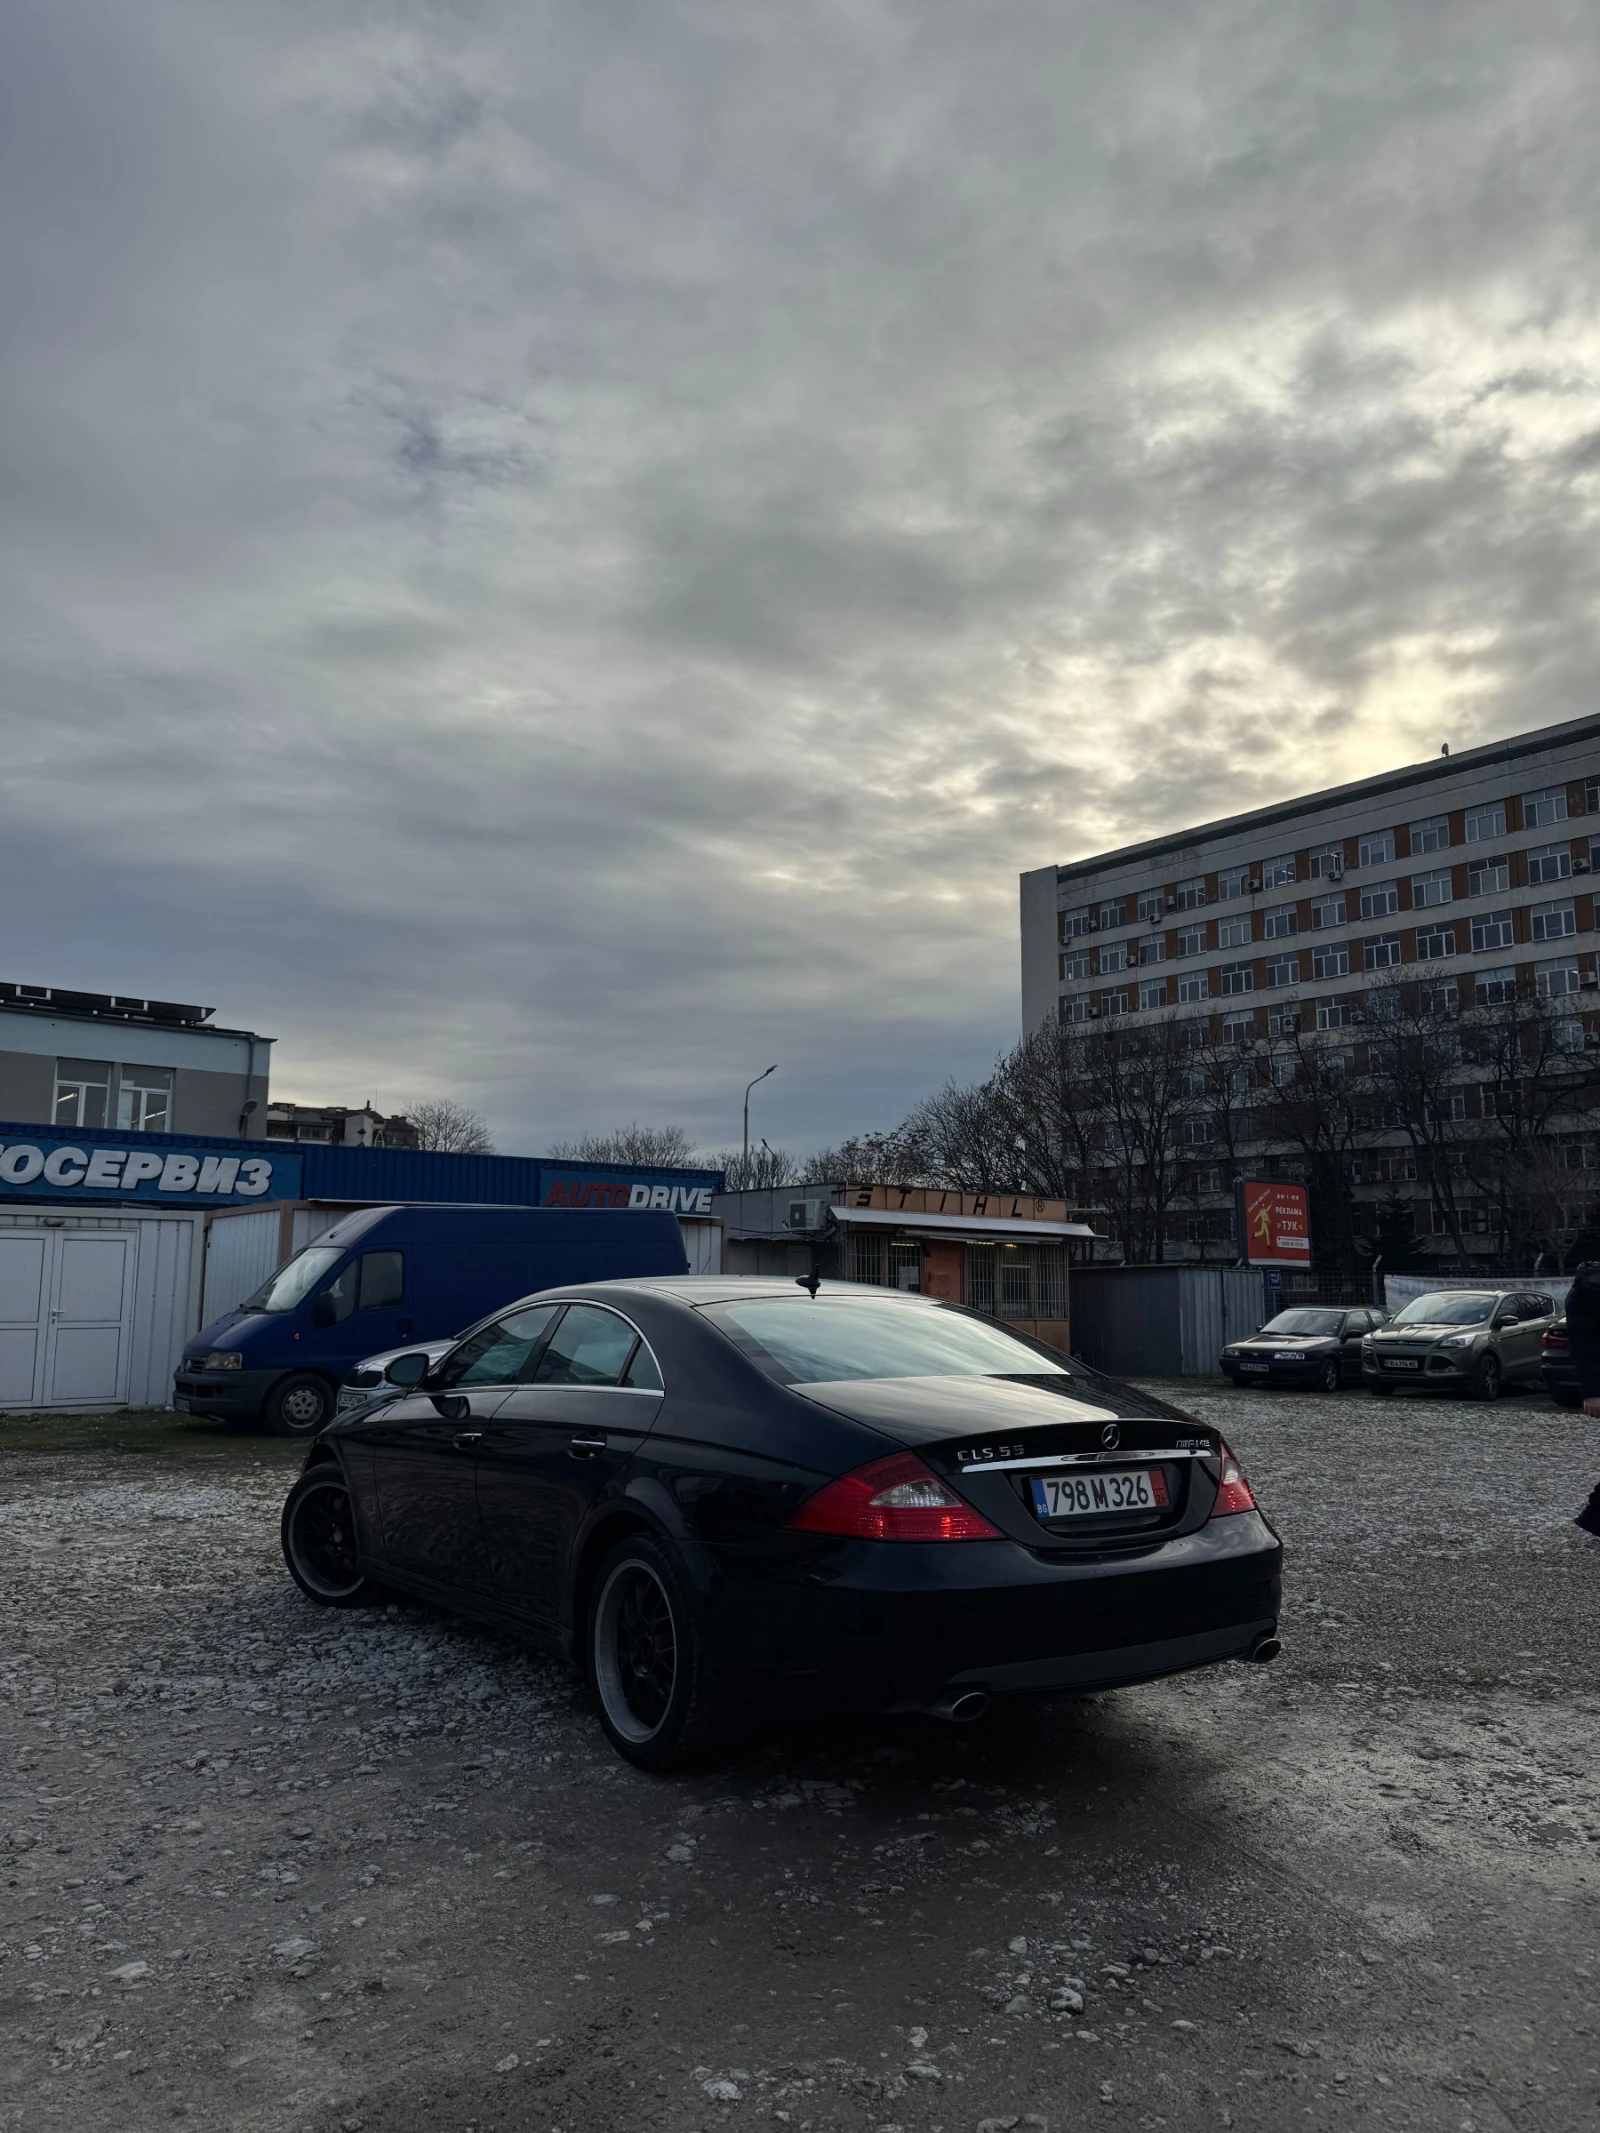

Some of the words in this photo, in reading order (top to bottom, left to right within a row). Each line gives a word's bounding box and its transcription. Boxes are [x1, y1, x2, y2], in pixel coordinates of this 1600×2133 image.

[0, 1144, 273, 1197] ОСЕРВИЗ
[1275, 1206, 1303, 1216] РЕКЛАМА
[1281, 1220, 1298, 1231] ТУК
[957, 1447, 994, 1462] CLS
[999, 1444, 1025, 1457] 55
[1037, 1503, 1048, 1514] BG
